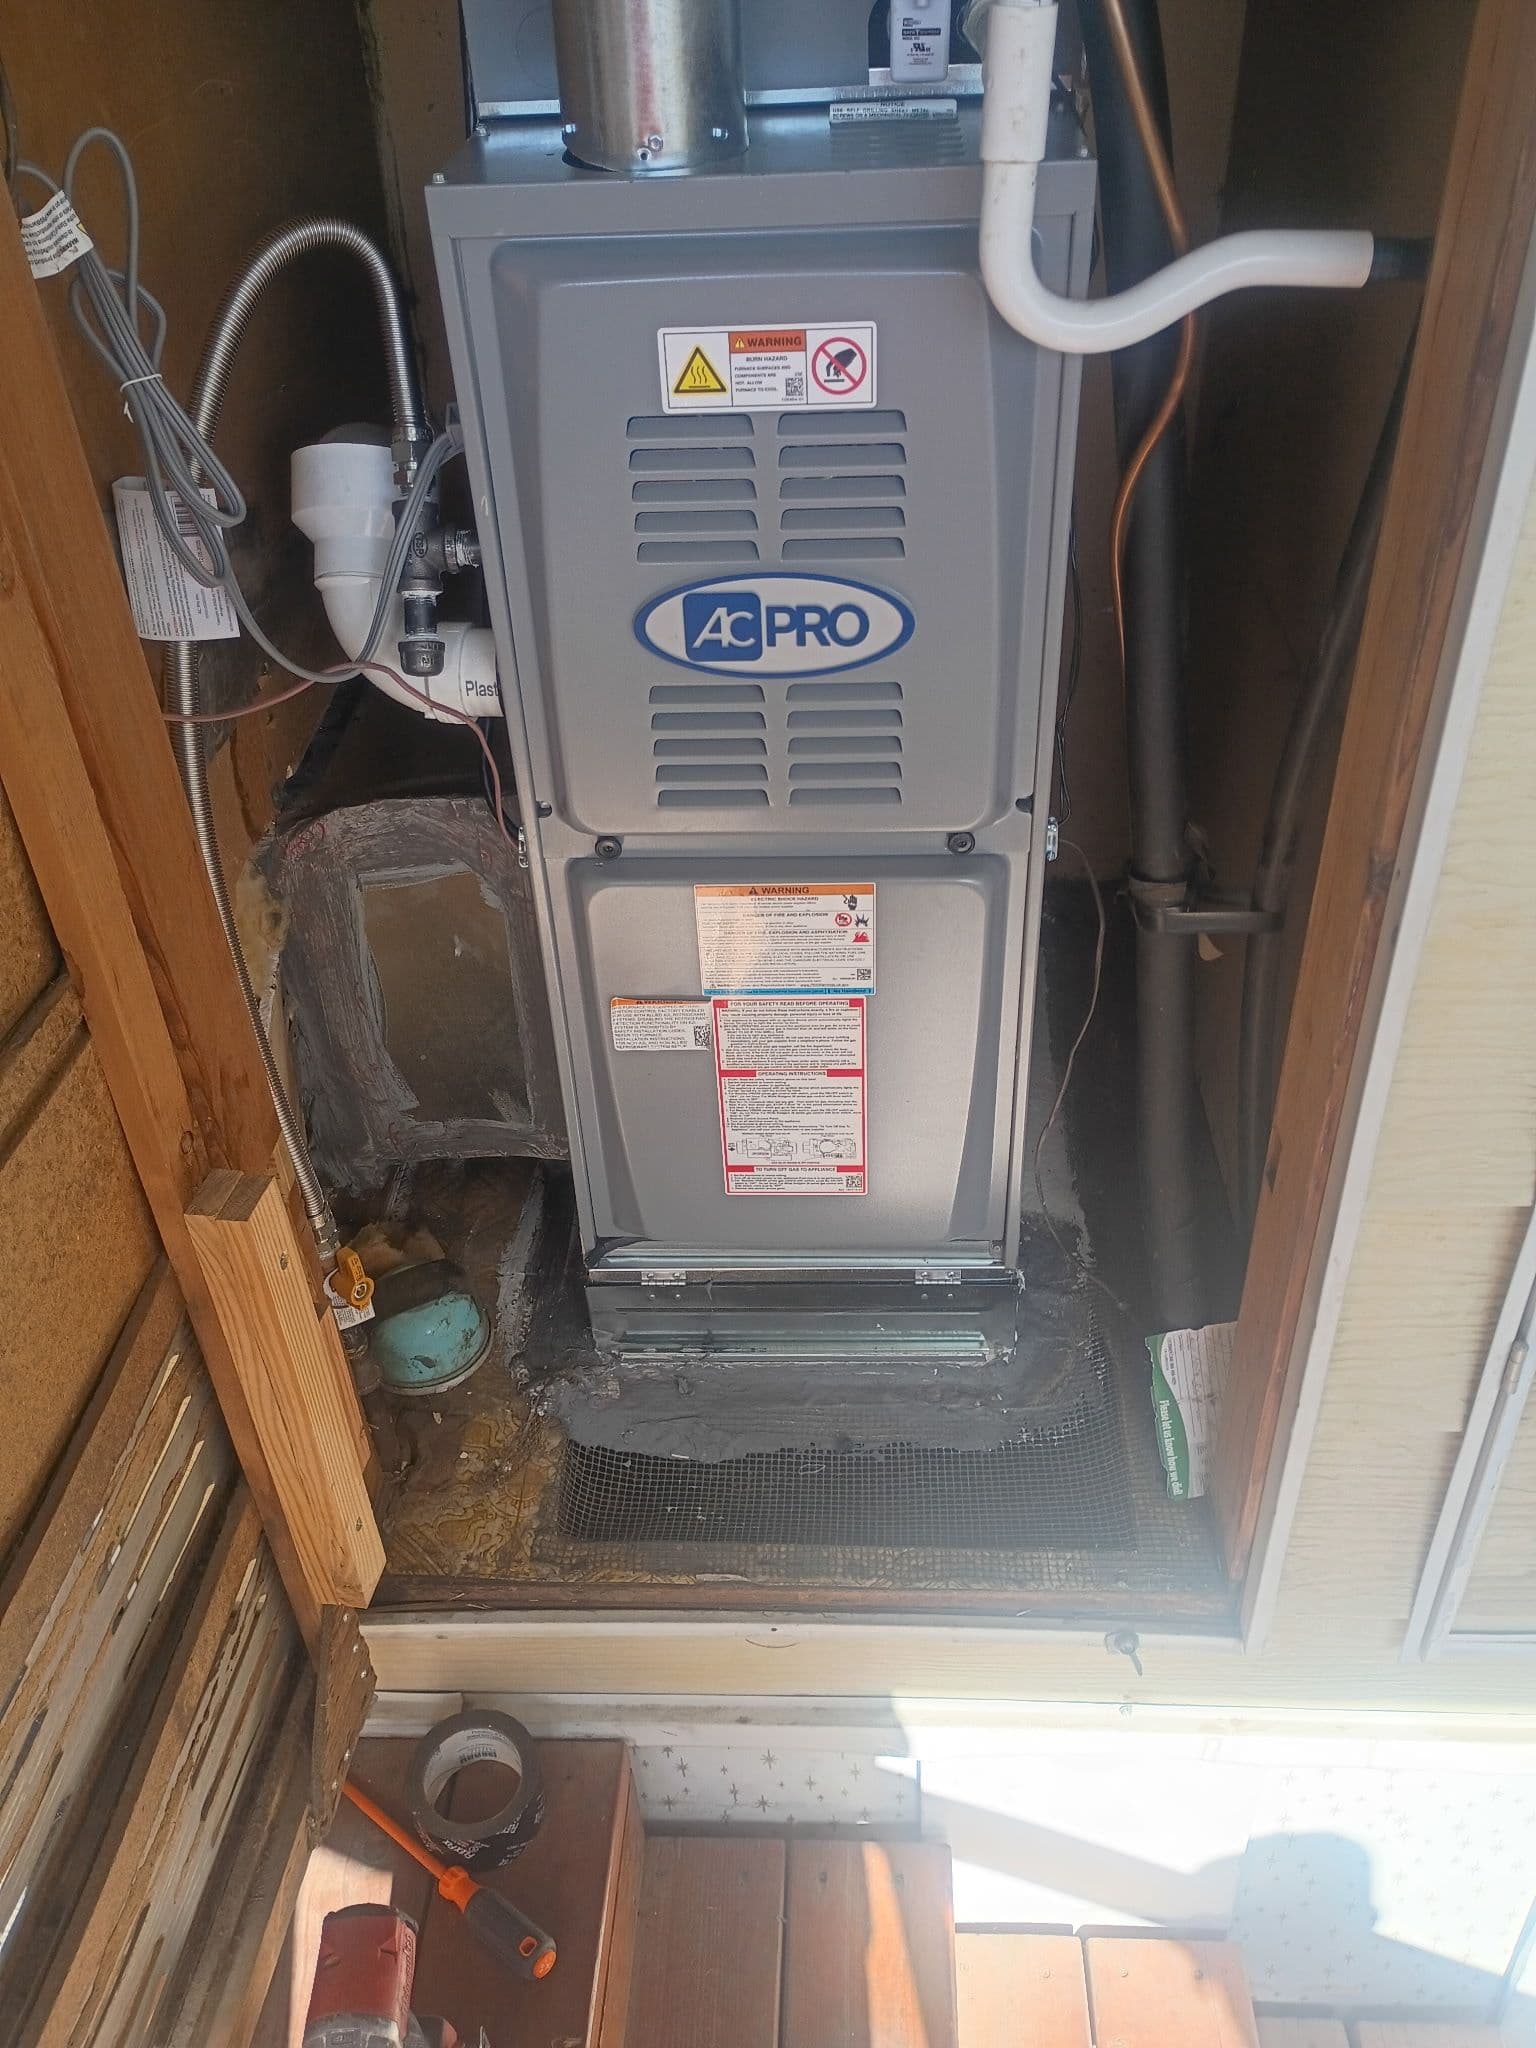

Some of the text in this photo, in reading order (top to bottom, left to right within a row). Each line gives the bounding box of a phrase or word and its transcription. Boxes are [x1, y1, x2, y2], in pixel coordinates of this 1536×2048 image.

[747, 336, 801, 347] WARNING
[691, 603, 870, 649] AC PRO
[1159, 1400, 1170, 1421] Please
[1162, 1420, 1170, 1429] let
[1164, 1430, 1171, 1438] us
[1165, 1438, 1175, 1456] know
[1168, 1456, 1178, 1471] how
[1170, 1471, 1177, 1482] we
